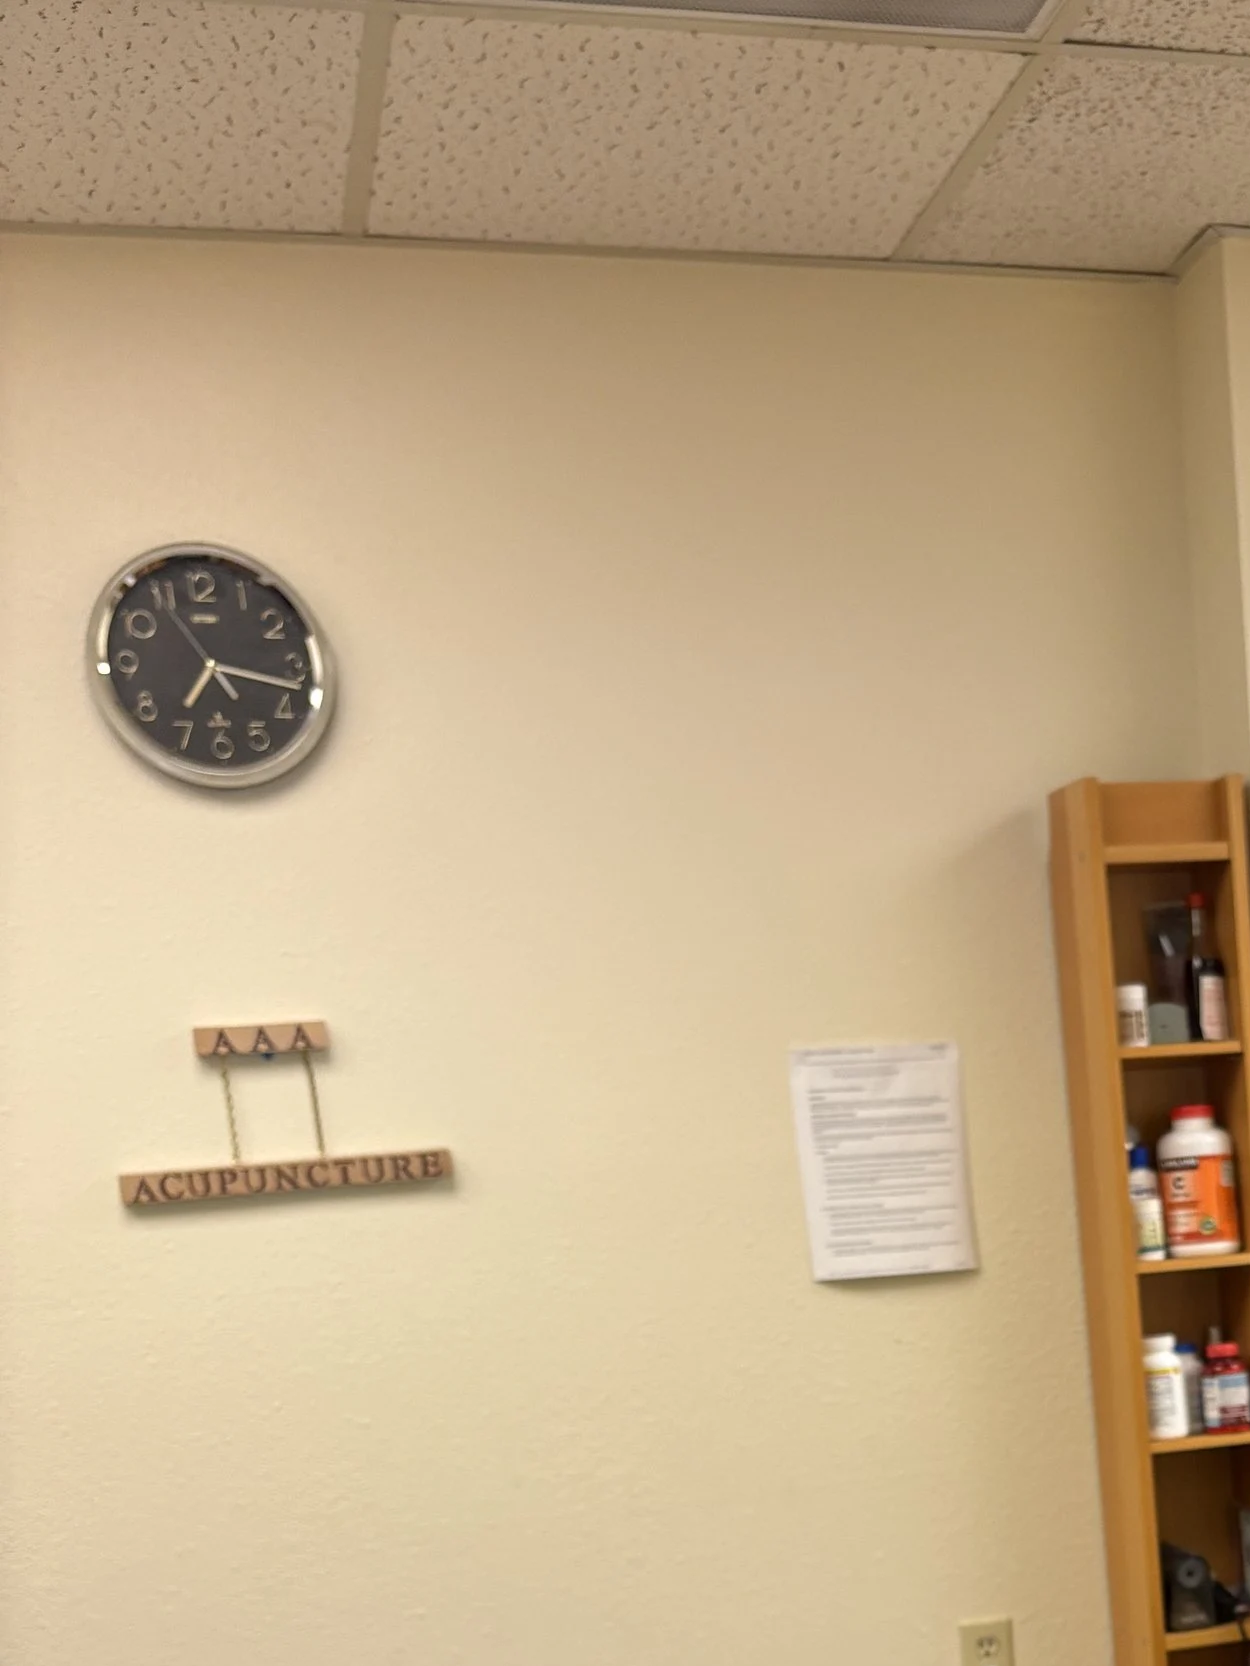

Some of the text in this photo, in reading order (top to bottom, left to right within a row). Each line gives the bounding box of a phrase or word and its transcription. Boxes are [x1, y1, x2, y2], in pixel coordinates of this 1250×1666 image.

[150, 579, 176, 610] 11
[185, 569, 217, 603] 12
[236, 579, 247, 610] 1
[260, 608, 285, 640] 2
[116, 649, 139, 680] 9
[285, 652, 306, 685] 3
[137, 690, 158, 722] 8
[275, 693, 295, 719] 4
[172, 721, 193, 750] 7
[211, 728, 235, 760] 6
[248, 721, 270, 751] 5
[132, 1151, 444, 1204] ACUPUNCTURE
